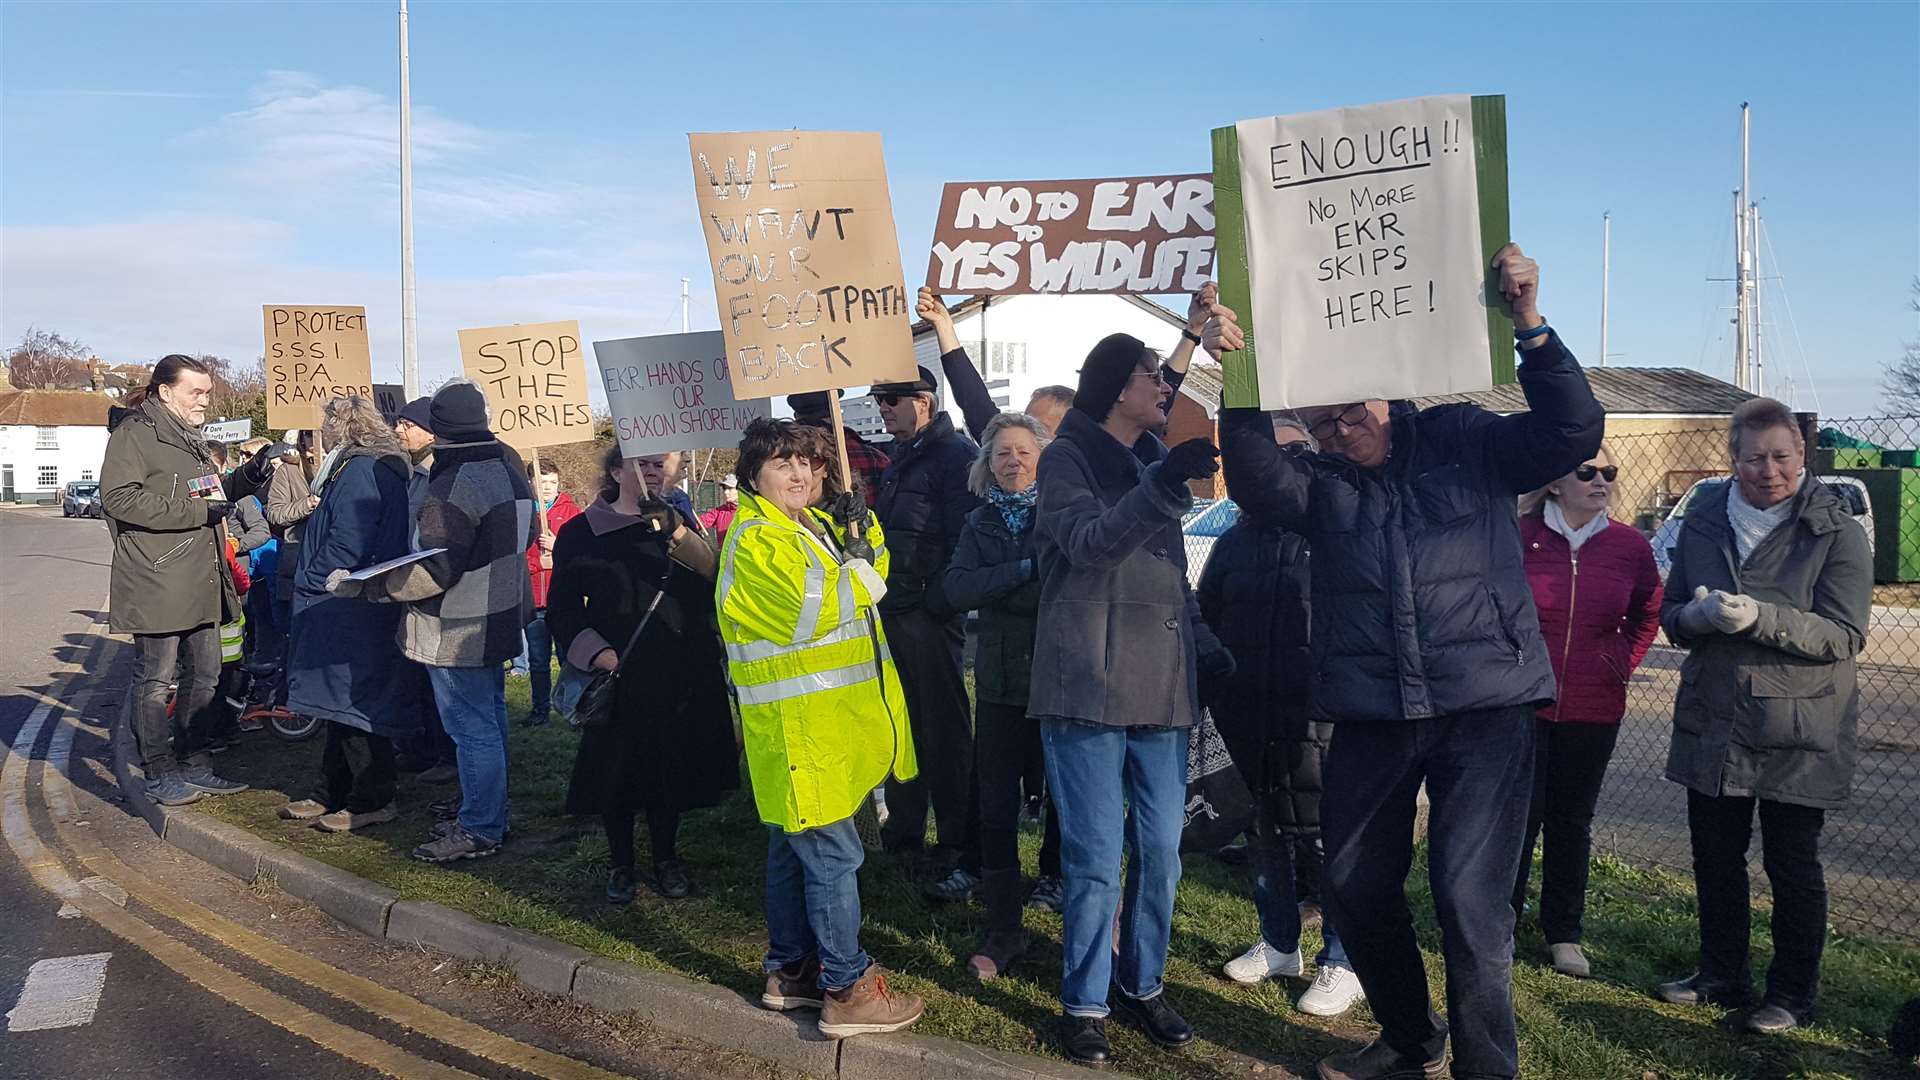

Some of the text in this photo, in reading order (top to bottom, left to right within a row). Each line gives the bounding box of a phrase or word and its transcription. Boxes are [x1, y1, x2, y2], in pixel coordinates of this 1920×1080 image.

[698, 143, 798, 200] WE
[954, 178, 1216, 234] NO TO EKR
[711, 207, 854, 246] WANT
[1011, 224, 1043, 242] TO
[1334, 212, 1405, 250] EKR
[718, 246, 820, 285] OUR
[932, 235, 1216, 294] YES WILDLIFE
[1317, 245, 1407, 281] SKIPS
[273, 309, 366, 337] PROTECT
[729, 284, 907, 337] FOOTPATH
[479, 335, 578, 374] STOP
[646, 360, 704, 387] HANDS
[738, 334, 852, 384] BACK
[489, 373, 567, 399] THE
[673, 384, 705, 410] OUR
[491, 403, 591, 435] ORRIES
[618, 414, 676, 441] SAXON
